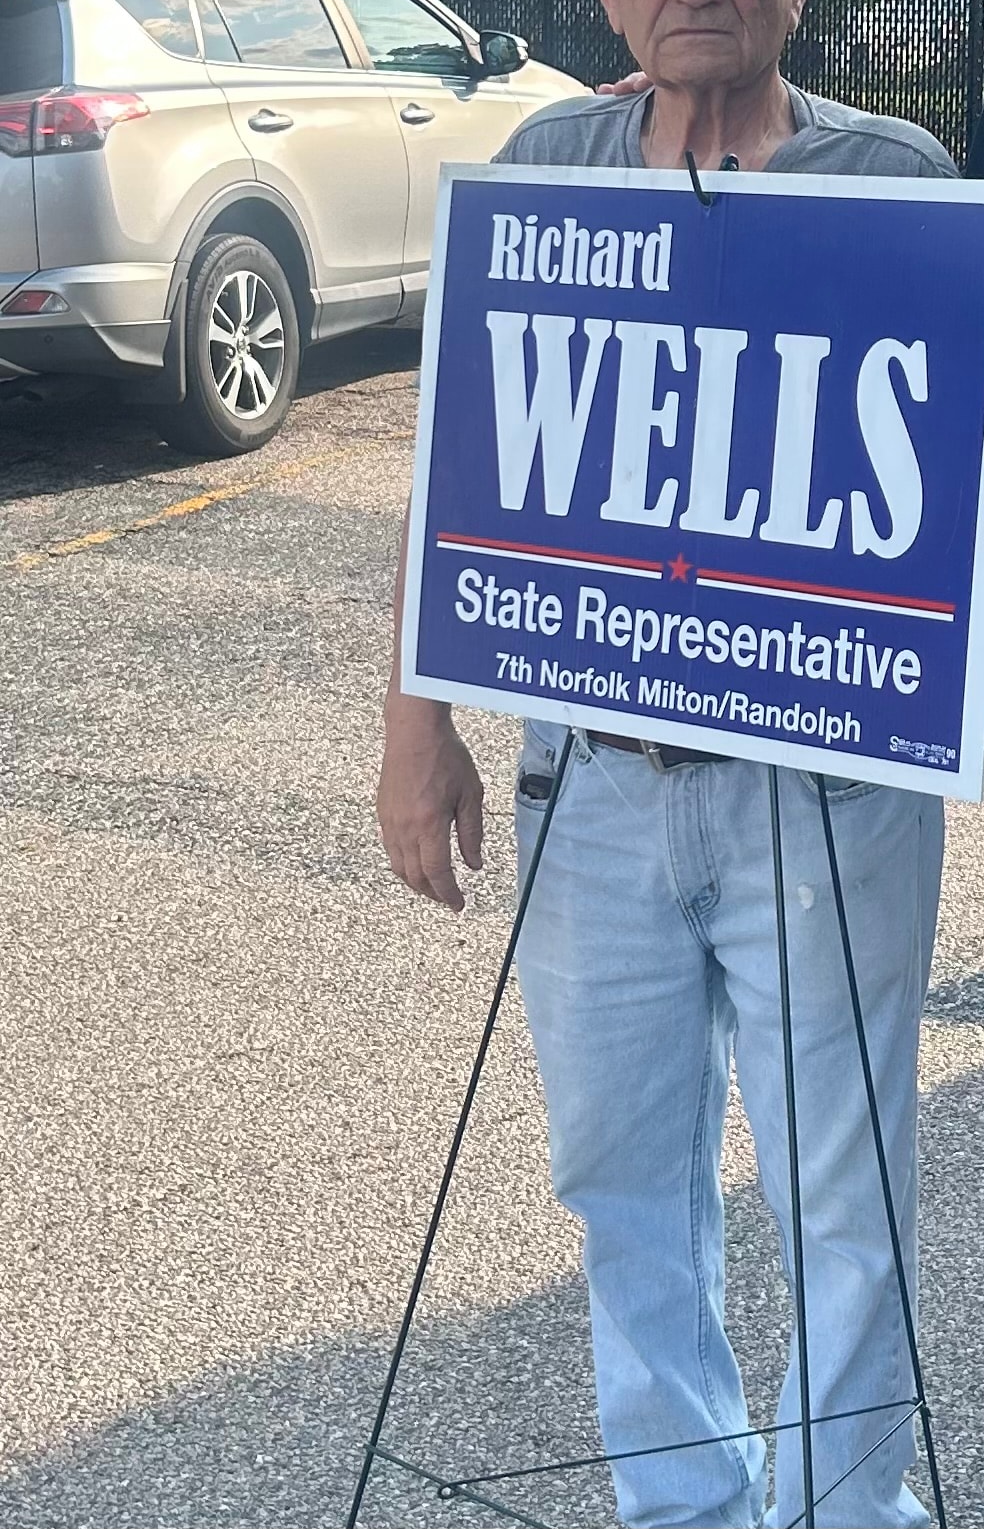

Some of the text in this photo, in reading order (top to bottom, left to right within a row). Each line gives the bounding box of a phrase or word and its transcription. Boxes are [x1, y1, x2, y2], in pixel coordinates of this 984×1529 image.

[488, 214, 672, 291] Richard
[487, 311, 927, 558] WELLS
[456, 569, 920, 694] State Representative
[497, 653, 860, 744] 7th Norfolk Milton/Randolph
